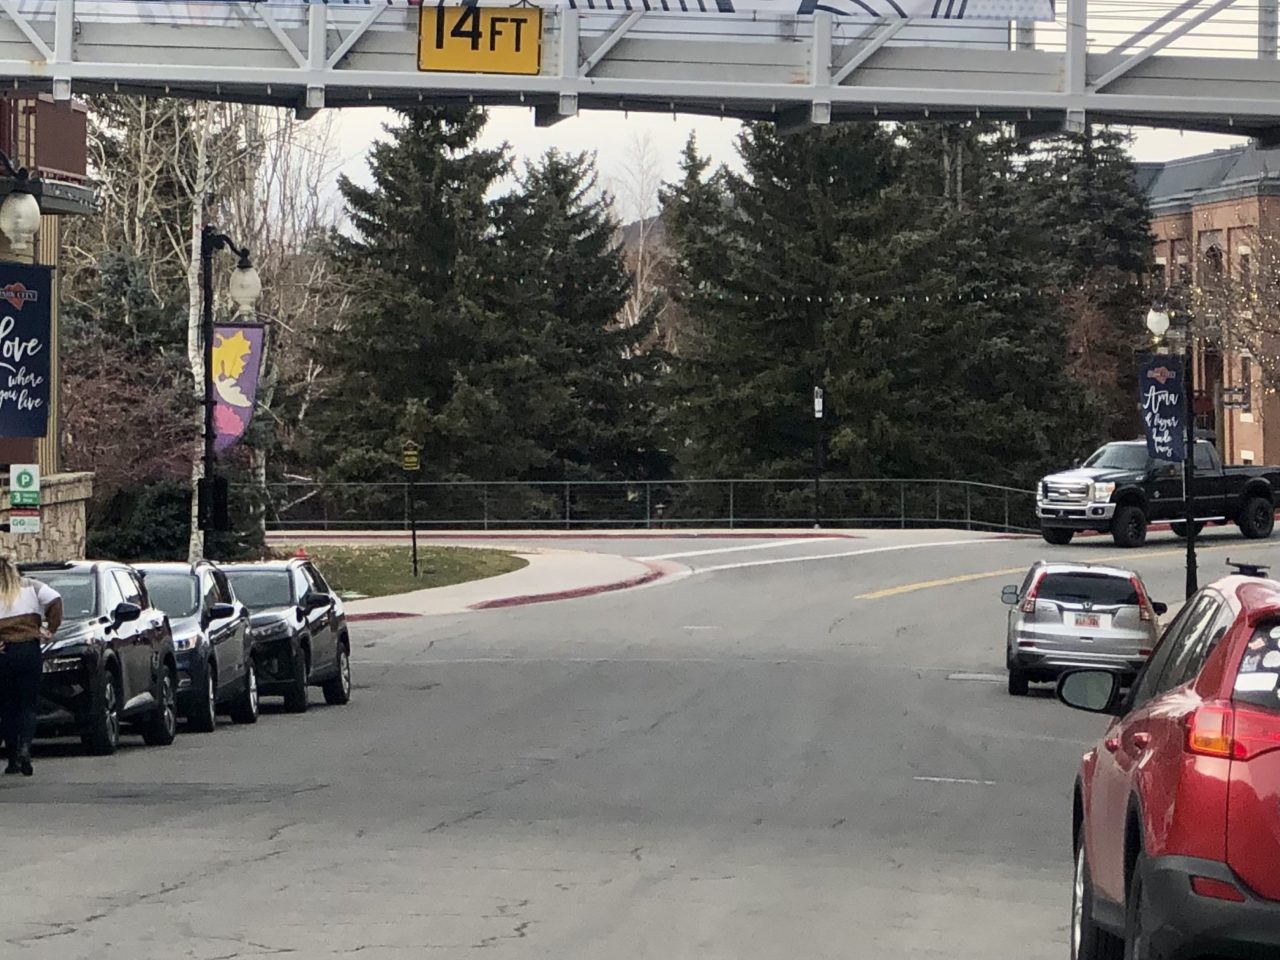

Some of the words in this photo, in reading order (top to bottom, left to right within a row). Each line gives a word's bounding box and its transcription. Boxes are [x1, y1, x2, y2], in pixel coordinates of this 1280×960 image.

[435, 5, 483, 50] 14
[489, 16, 528, 52] FT
[8, 366, 44, 388] where
[18, 389, 44, 411] live
[1142, 385, 1179, 413] Ama
[21, 474, 30, 486] P
[13, 492, 21, 503] 3
